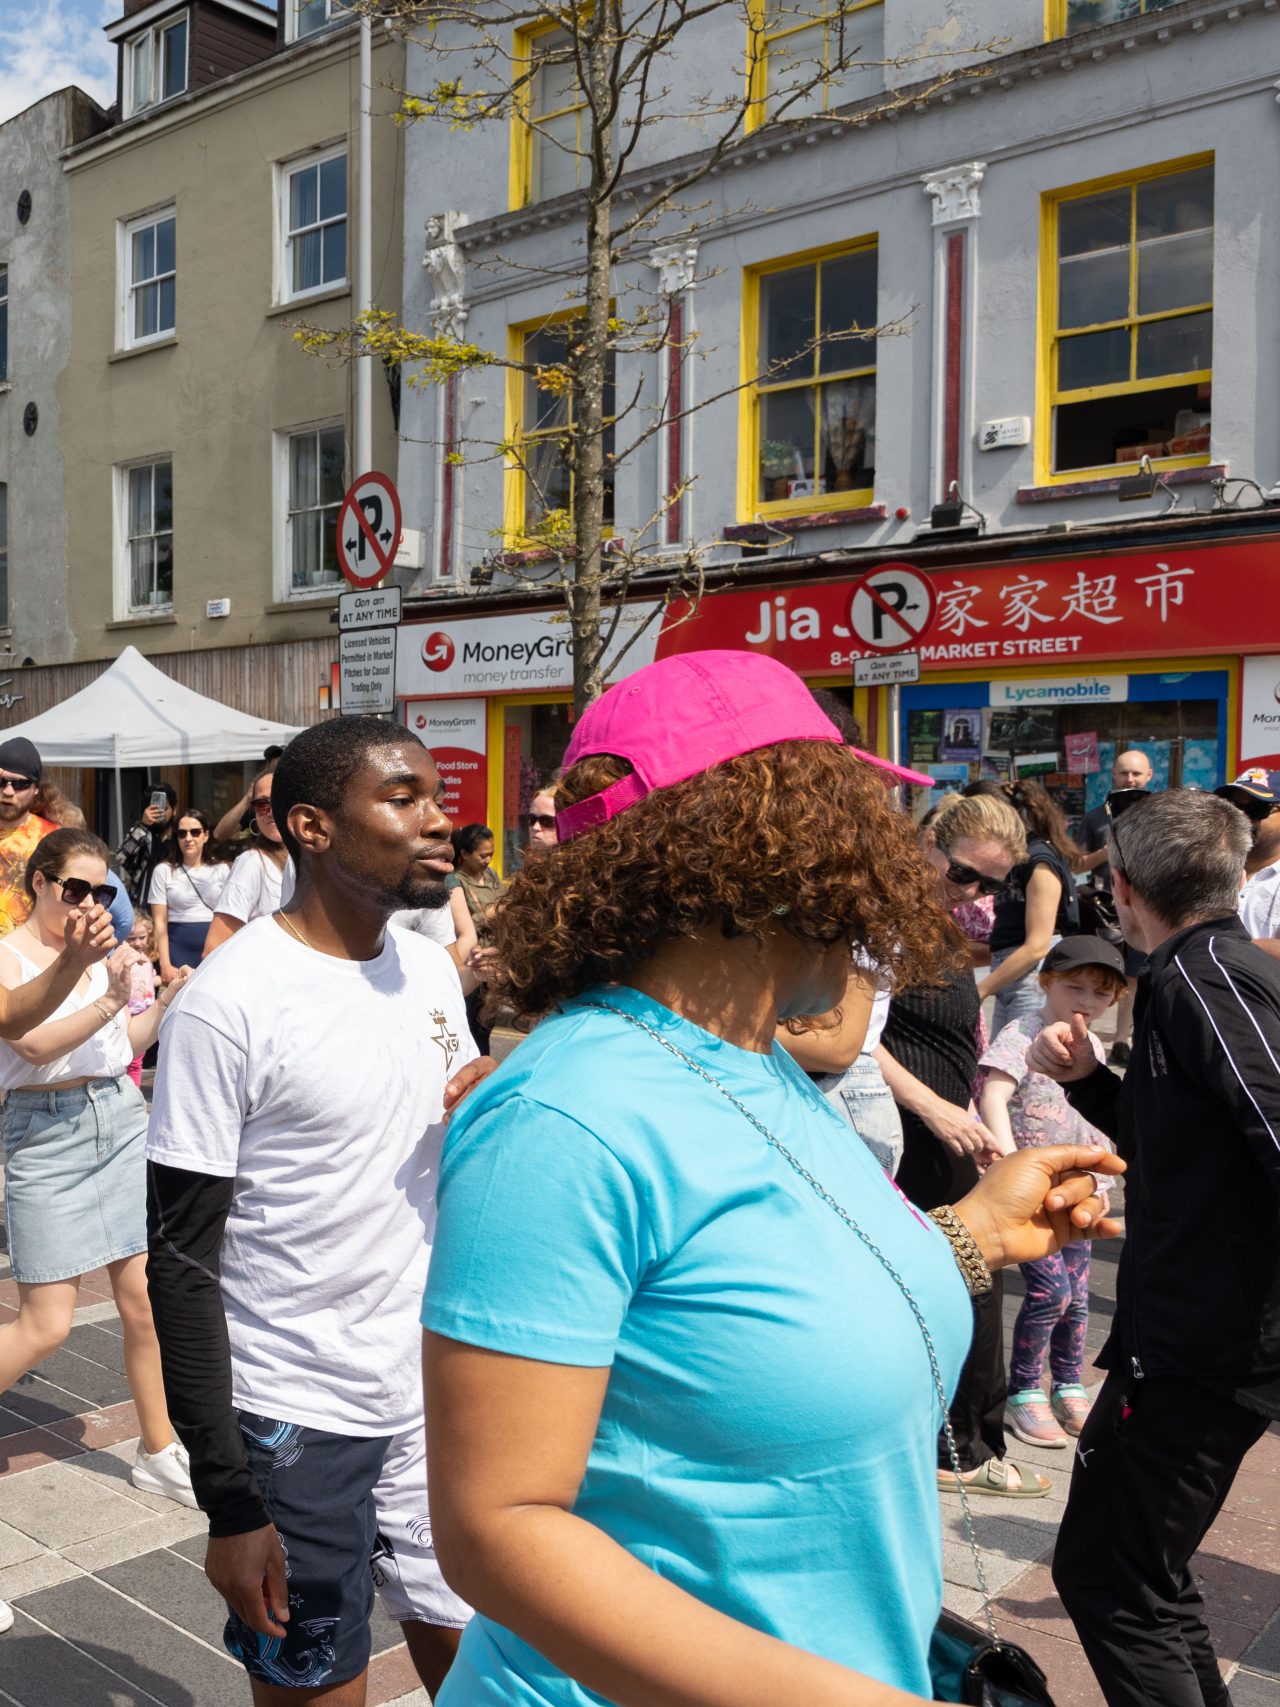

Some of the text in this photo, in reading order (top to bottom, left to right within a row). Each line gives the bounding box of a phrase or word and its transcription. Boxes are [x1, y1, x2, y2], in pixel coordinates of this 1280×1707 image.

[936, 562, 1195, 637] 家家超市
[342, 608, 398, 623] AT ANY TIME
[745, 596, 820, 644] Jia
[344, 635, 391, 649] Licensed Vehicles
[920, 641, 1000, 661] MARKET
[1002, 636, 1082, 655] STREET
[341, 650, 393, 663] Permitted in Marked
[344, 665, 390, 678] Pitches for Casual
[463, 664, 564, 685] money transfer
[857, 669, 916, 682] AT ANY TIME
[351, 681, 382, 693] Trading Only
[1005, 682, 1111, 701] Lycamobile
[429, 717, 476, 728] MoneyGram
[436, 761, 479, 770] Food Store
